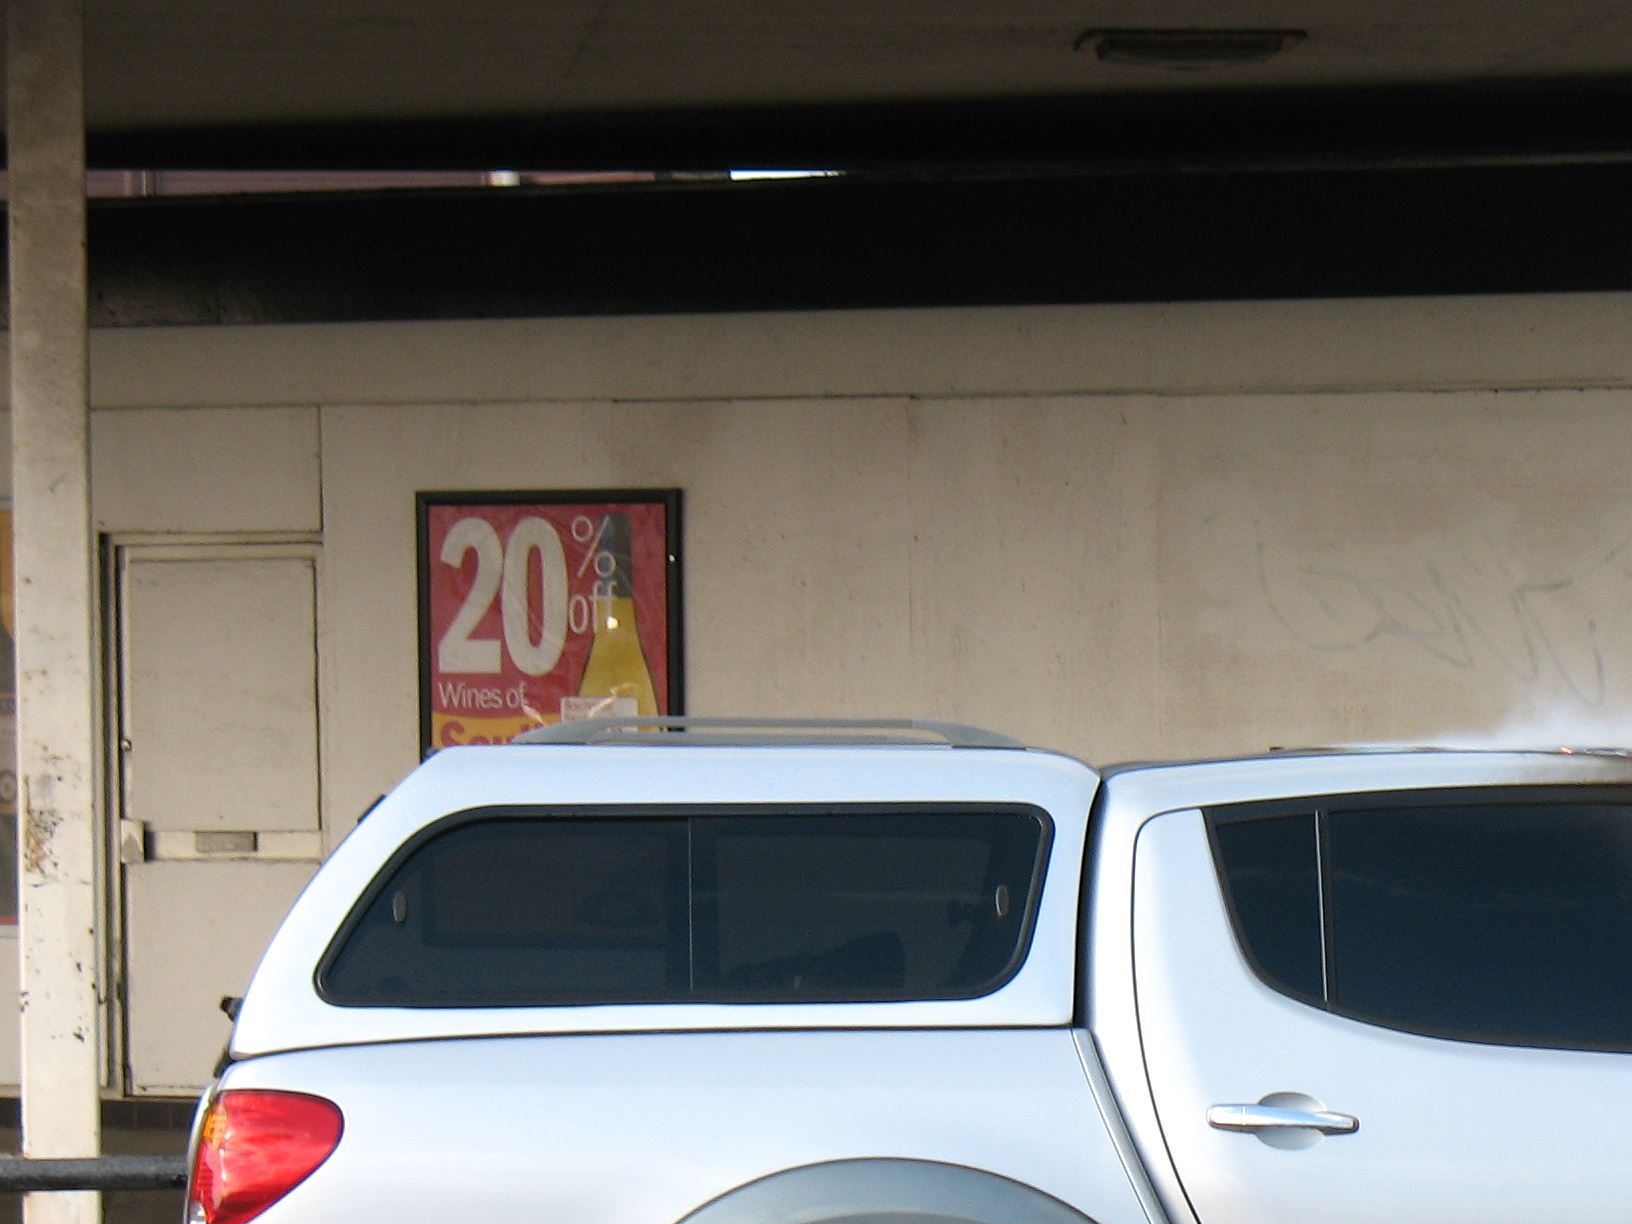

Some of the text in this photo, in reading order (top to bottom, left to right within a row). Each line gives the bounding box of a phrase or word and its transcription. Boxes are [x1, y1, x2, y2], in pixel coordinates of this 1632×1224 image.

[568, 580, 618, 634] off
[438, 681, 529, 709] Wines of
